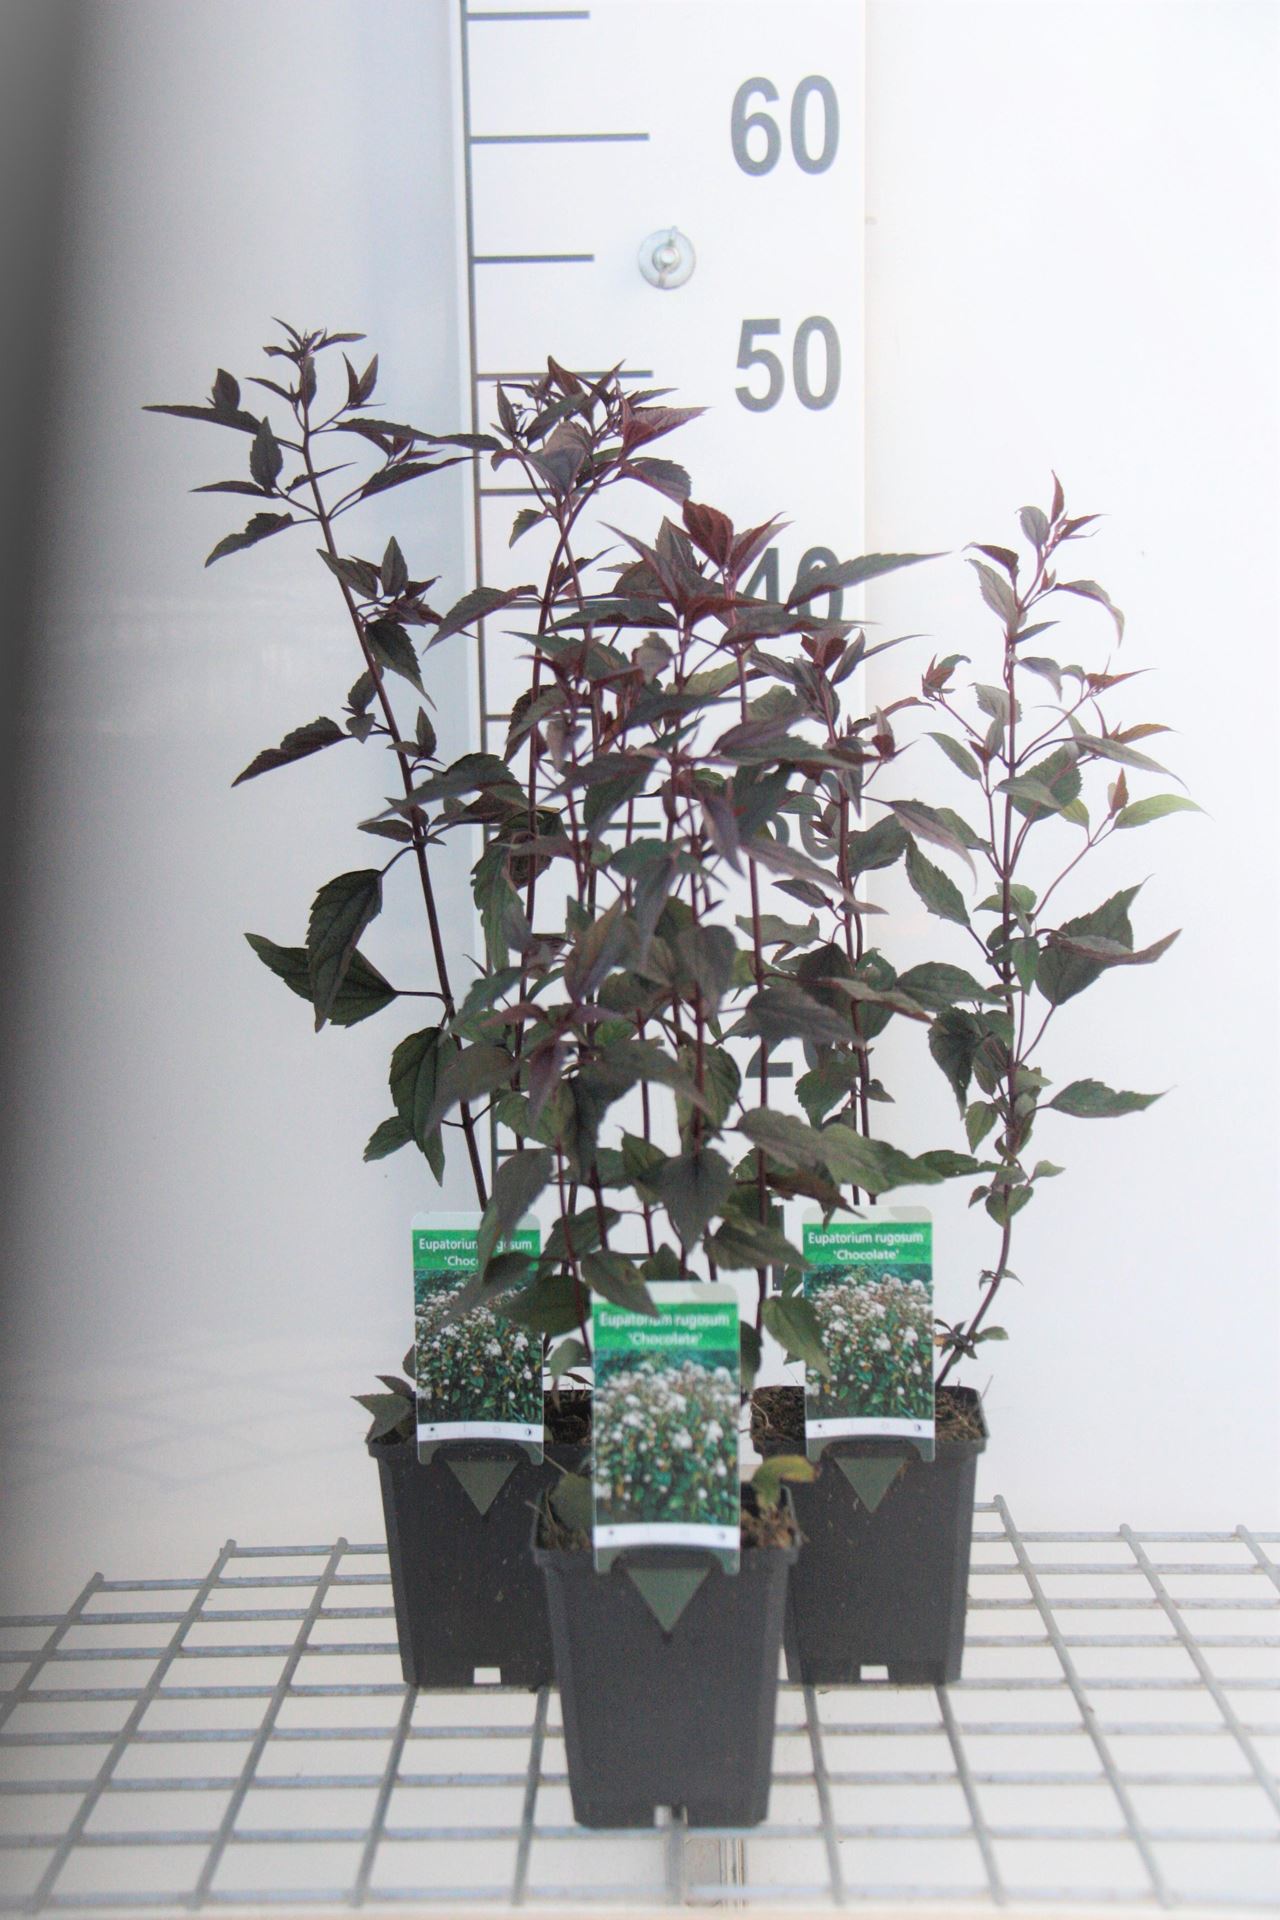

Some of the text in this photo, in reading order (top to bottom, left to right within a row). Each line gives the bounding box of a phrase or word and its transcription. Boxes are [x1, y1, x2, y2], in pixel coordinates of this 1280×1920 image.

[730, 75, 840, 176] 60
[734, 315, 841, 412] 50
[808, 1231, 924, 1246] Eupatorium rugosum
[833, 1249, 900, 1261] 'Chocolate'
[675, 1315, 730, 1329] rugosum
